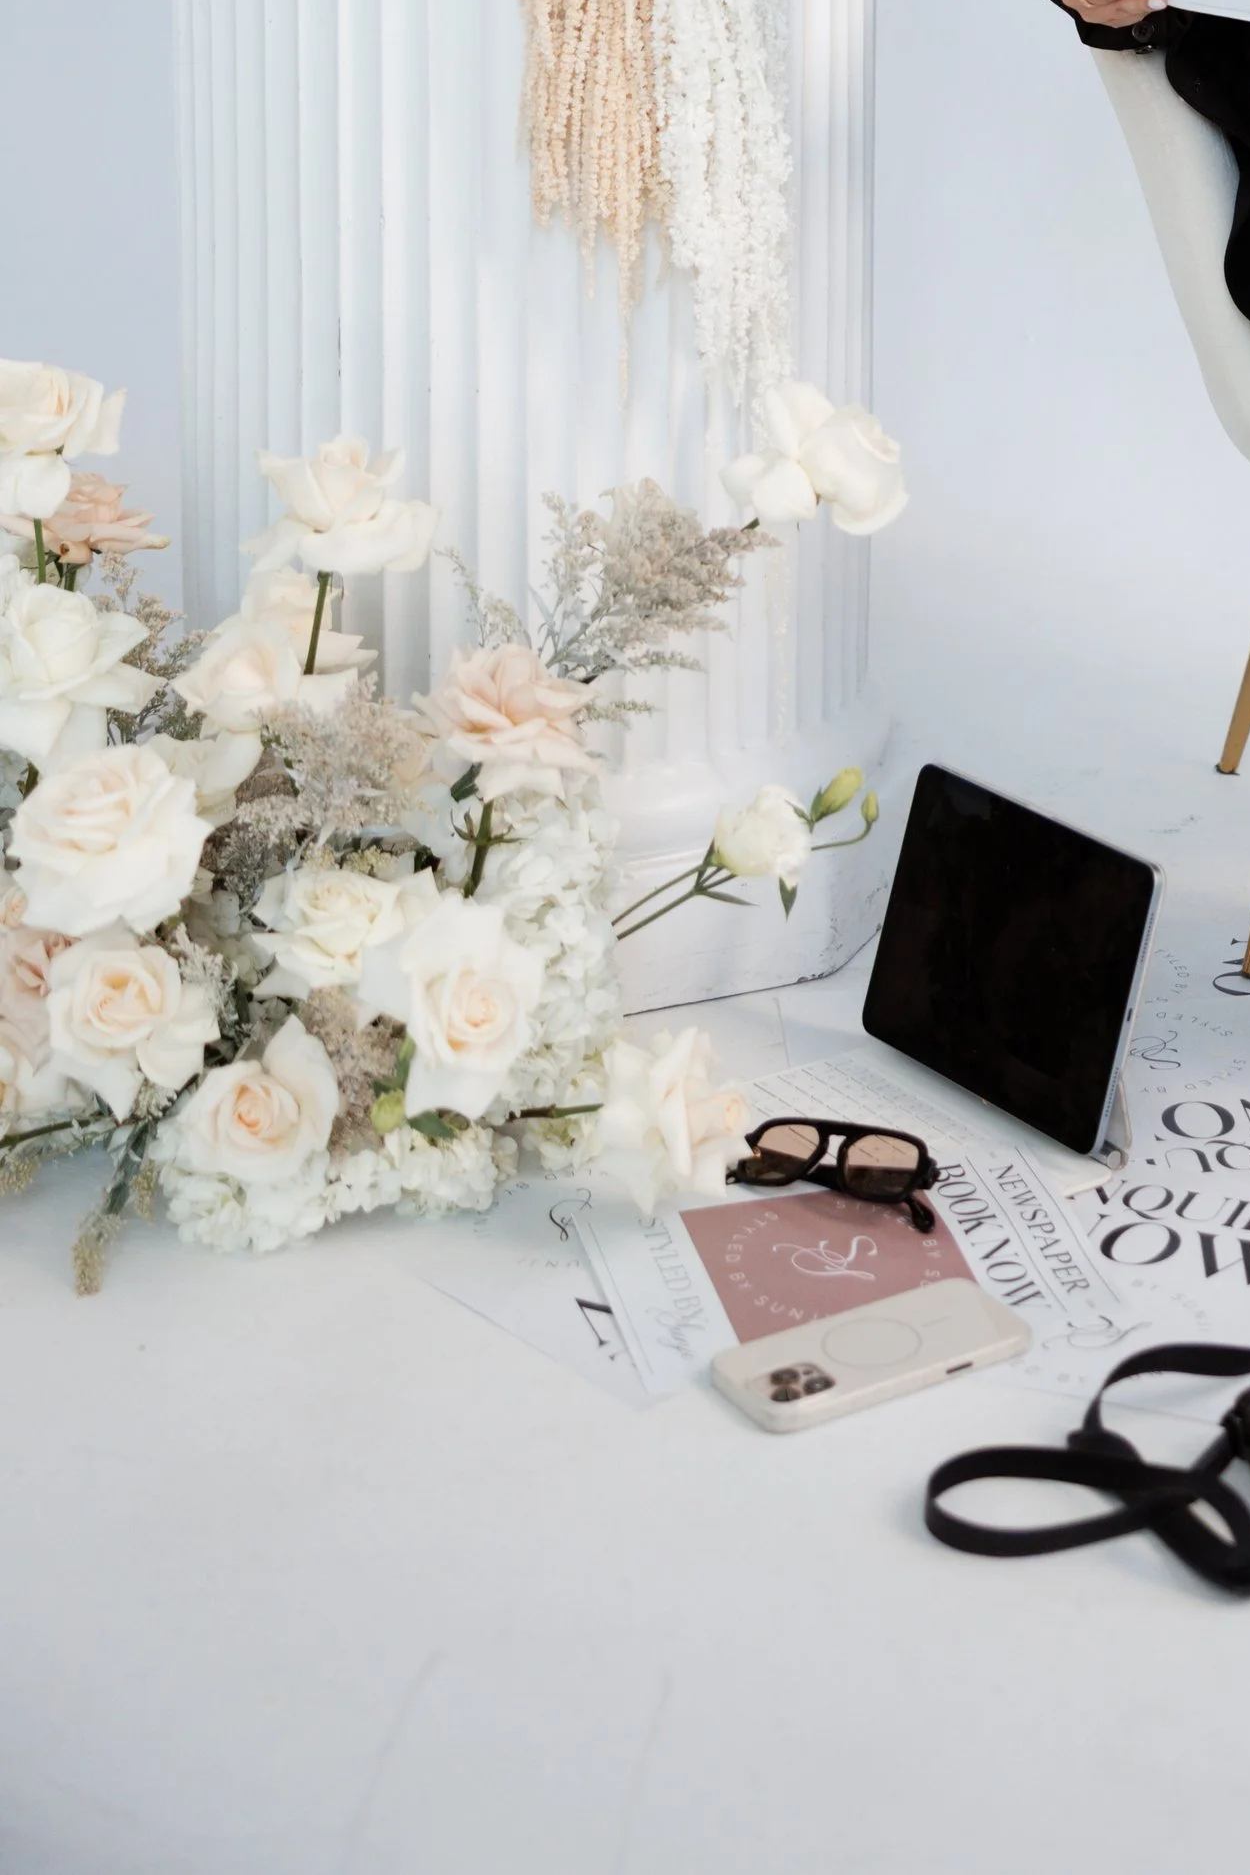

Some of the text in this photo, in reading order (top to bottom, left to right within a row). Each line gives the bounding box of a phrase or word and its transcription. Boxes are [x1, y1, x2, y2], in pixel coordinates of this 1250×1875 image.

[725, 1210, 779, 1264] STYLED
[935, 1162, 1004, 1236] BOOK
[970, 1237, 1052, 1309] NOW
[988, 1162, 1091, 1294] NEWSPAPER
[729, 1272, 753, 1291] BY
